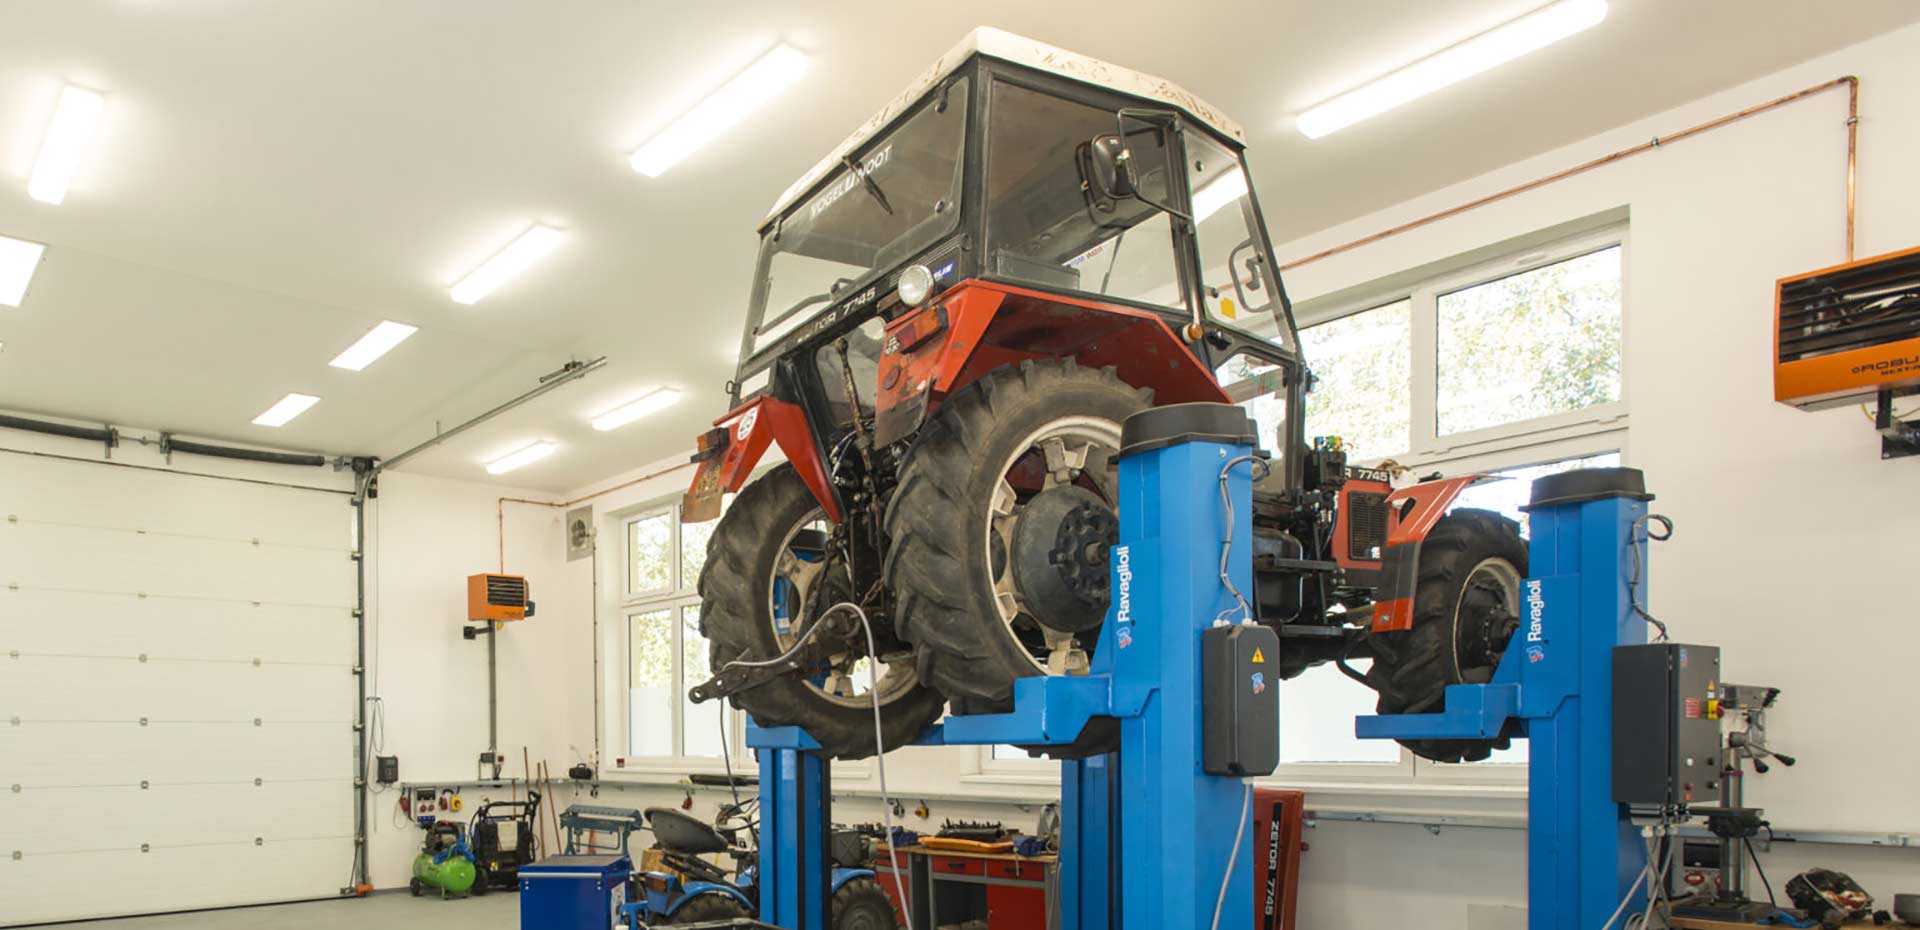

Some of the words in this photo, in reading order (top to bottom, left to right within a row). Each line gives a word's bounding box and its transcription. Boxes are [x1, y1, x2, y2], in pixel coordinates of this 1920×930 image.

[1357, 469, 1388, 481] 7745
[1116, 545, 1132, 623] Ravaglioli
[1526, 580, 1544, 642] Ravaglioli
[1268, 820, 1280, 870] ZETOR
[1264, 878, 1276, 916] 7745
